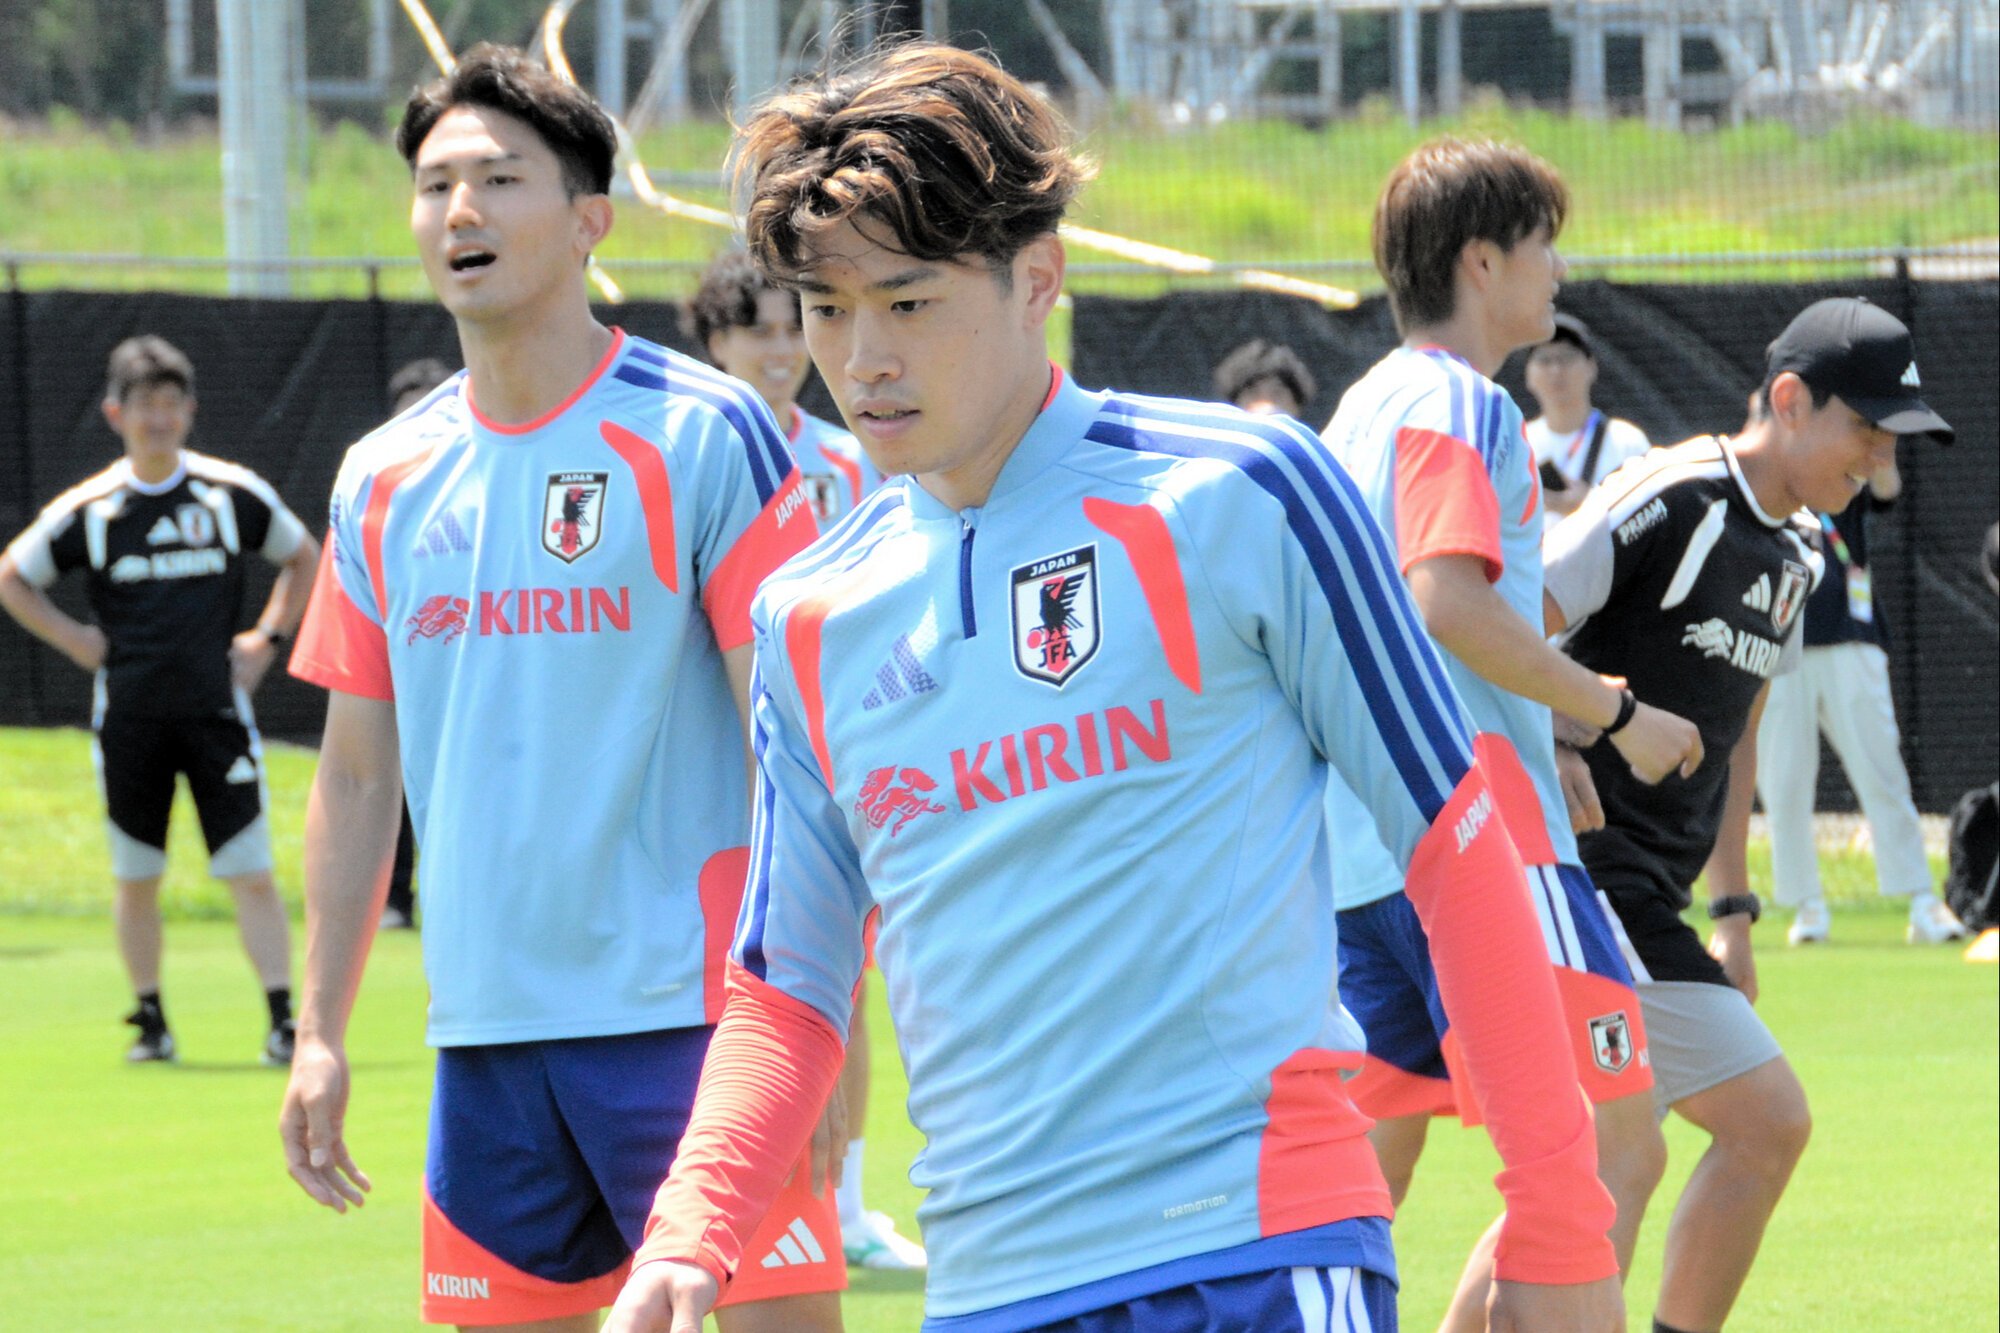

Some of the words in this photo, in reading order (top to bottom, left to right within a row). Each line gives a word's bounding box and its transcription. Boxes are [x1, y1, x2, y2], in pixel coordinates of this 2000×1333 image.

[560, 473, 595, 482] JAPAN
[774, 482, 808, 529] JAPAN
[1030, 553, 1077, 577] JAPAN
[479, 586, 631, 636] KIRIN
[1037, 640, 1078, 668] JFA
[949, 698, 1172, 813] KIRIN
[1454, 787, 1492, 855] JAPAN
[427, 1272, 491, 1300] KIRIN
